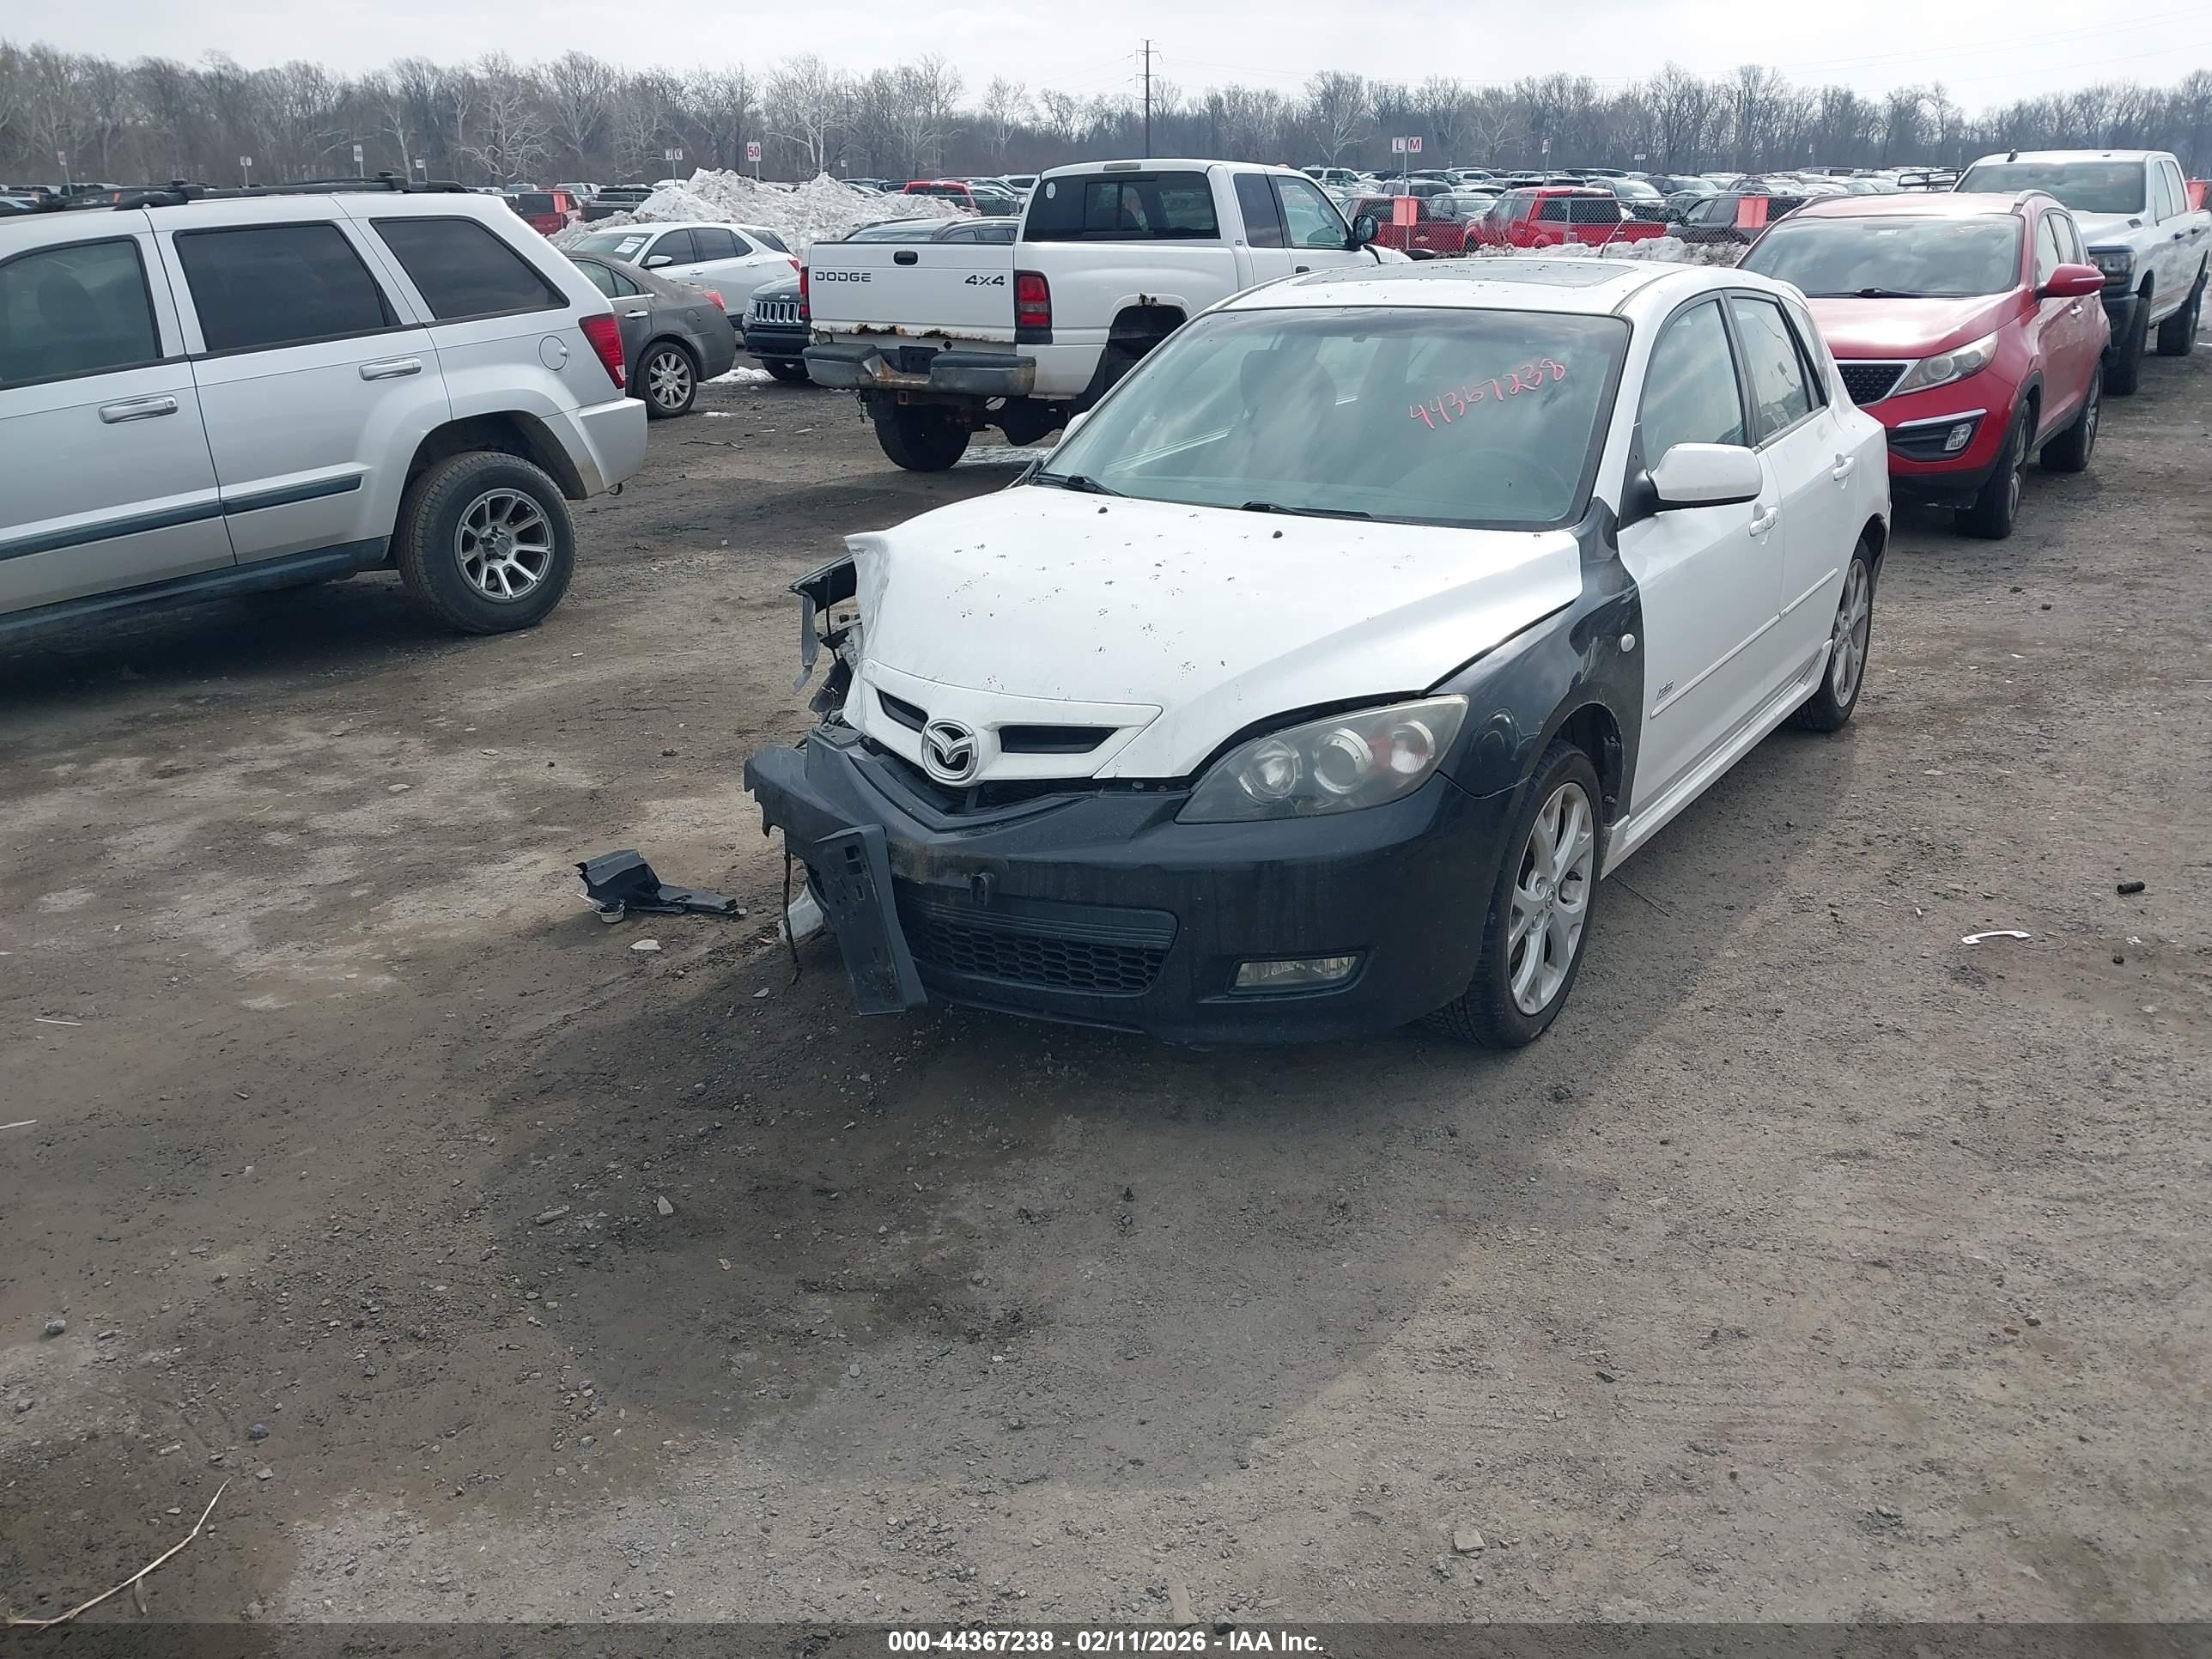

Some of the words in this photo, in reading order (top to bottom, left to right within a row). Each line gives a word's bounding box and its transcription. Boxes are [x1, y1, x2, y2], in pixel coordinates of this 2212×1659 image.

[1409, 139, 1420, 150] M
[748, 146, 760, 157] 50
[815, 271, 872, 283] DODGE
[1409, 357, 1566, 429] 44367238
